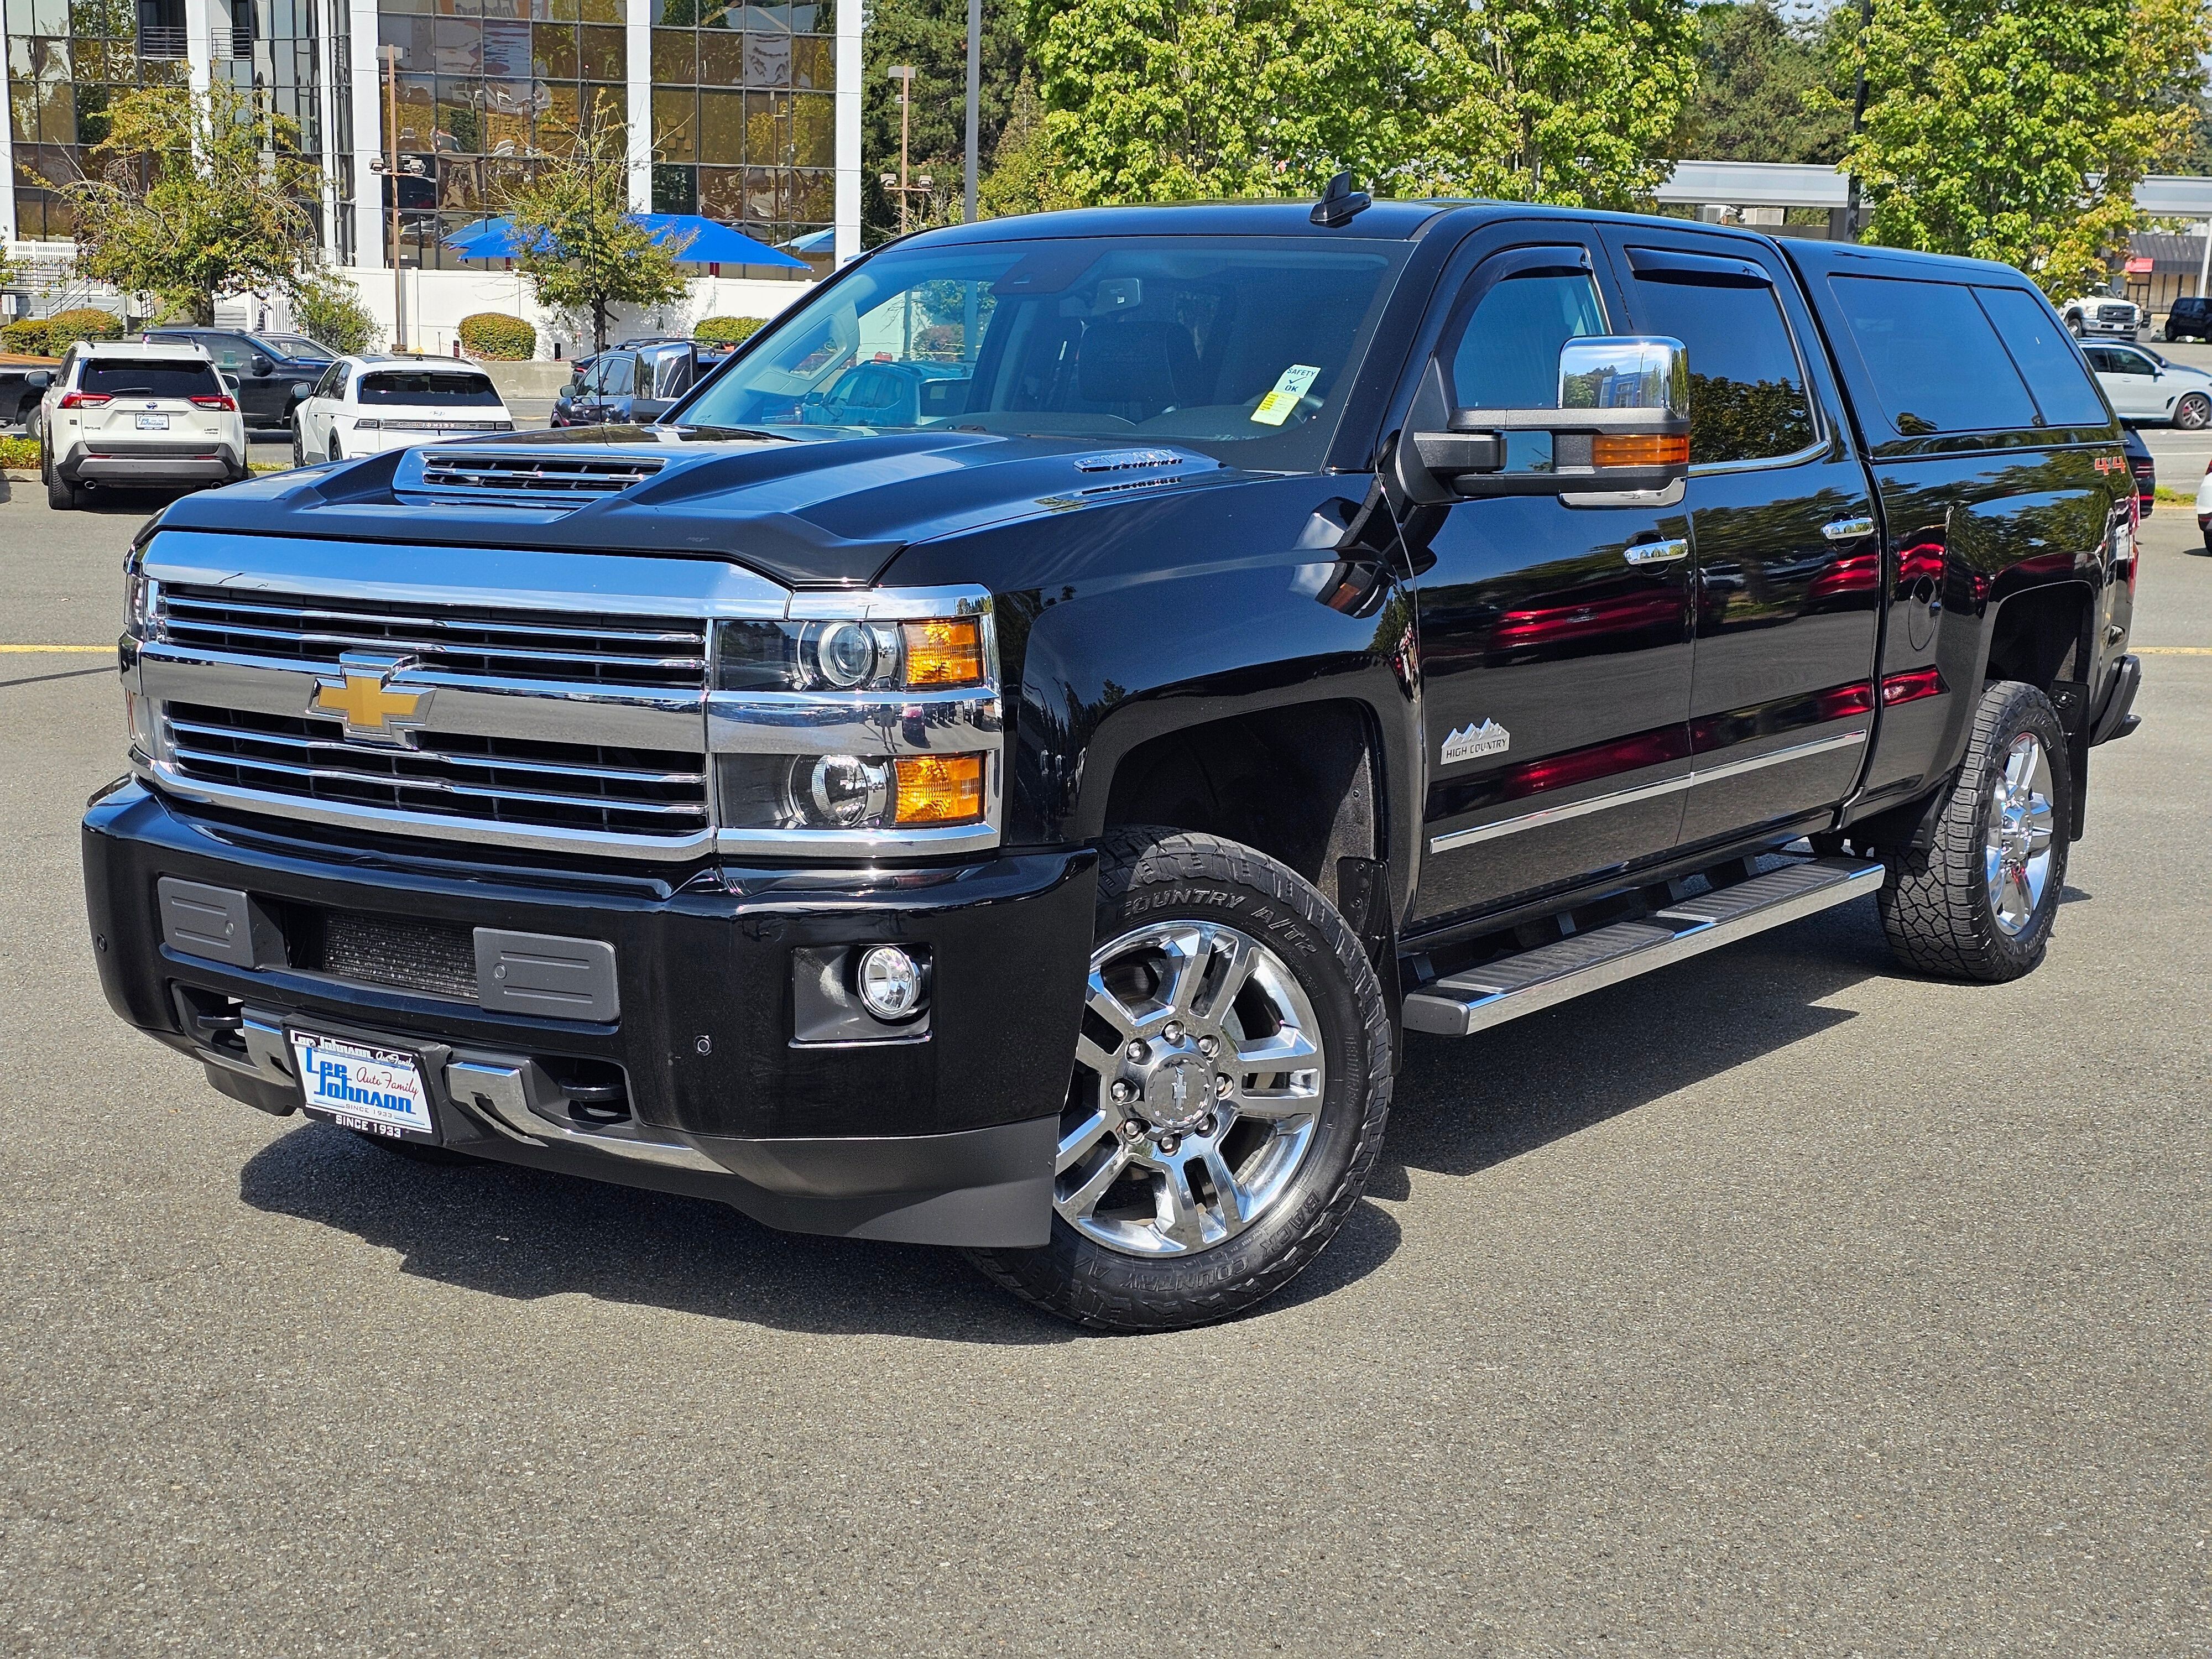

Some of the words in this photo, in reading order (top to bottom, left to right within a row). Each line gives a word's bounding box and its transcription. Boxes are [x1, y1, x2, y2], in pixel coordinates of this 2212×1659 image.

[1287, 368, 1316, 377] SAFETY
[1446, 747, 1467, 758] HIGH
[1470, 738, 1507, 754] COUNTRY
[1117, 888, 1247, 920] COUNTRY
[306, 1047, 347, 1078] Lee
[314, 1074, 416, 1115] Johnson
[357, 1067, 382, 1086] Auto
[381, 1072, 419, 1100] Family
[346, 1103, 369, 1112] SINCE
[373, 1108, 392, 1118] 1933
[336, 1115, 368, 1130] SINCE
[374, 1123, 401, 1138] 1933
[1259, 1189, 1322, 1259] BACK
[1120, 1255, 1249, 1291] COUNTRY
